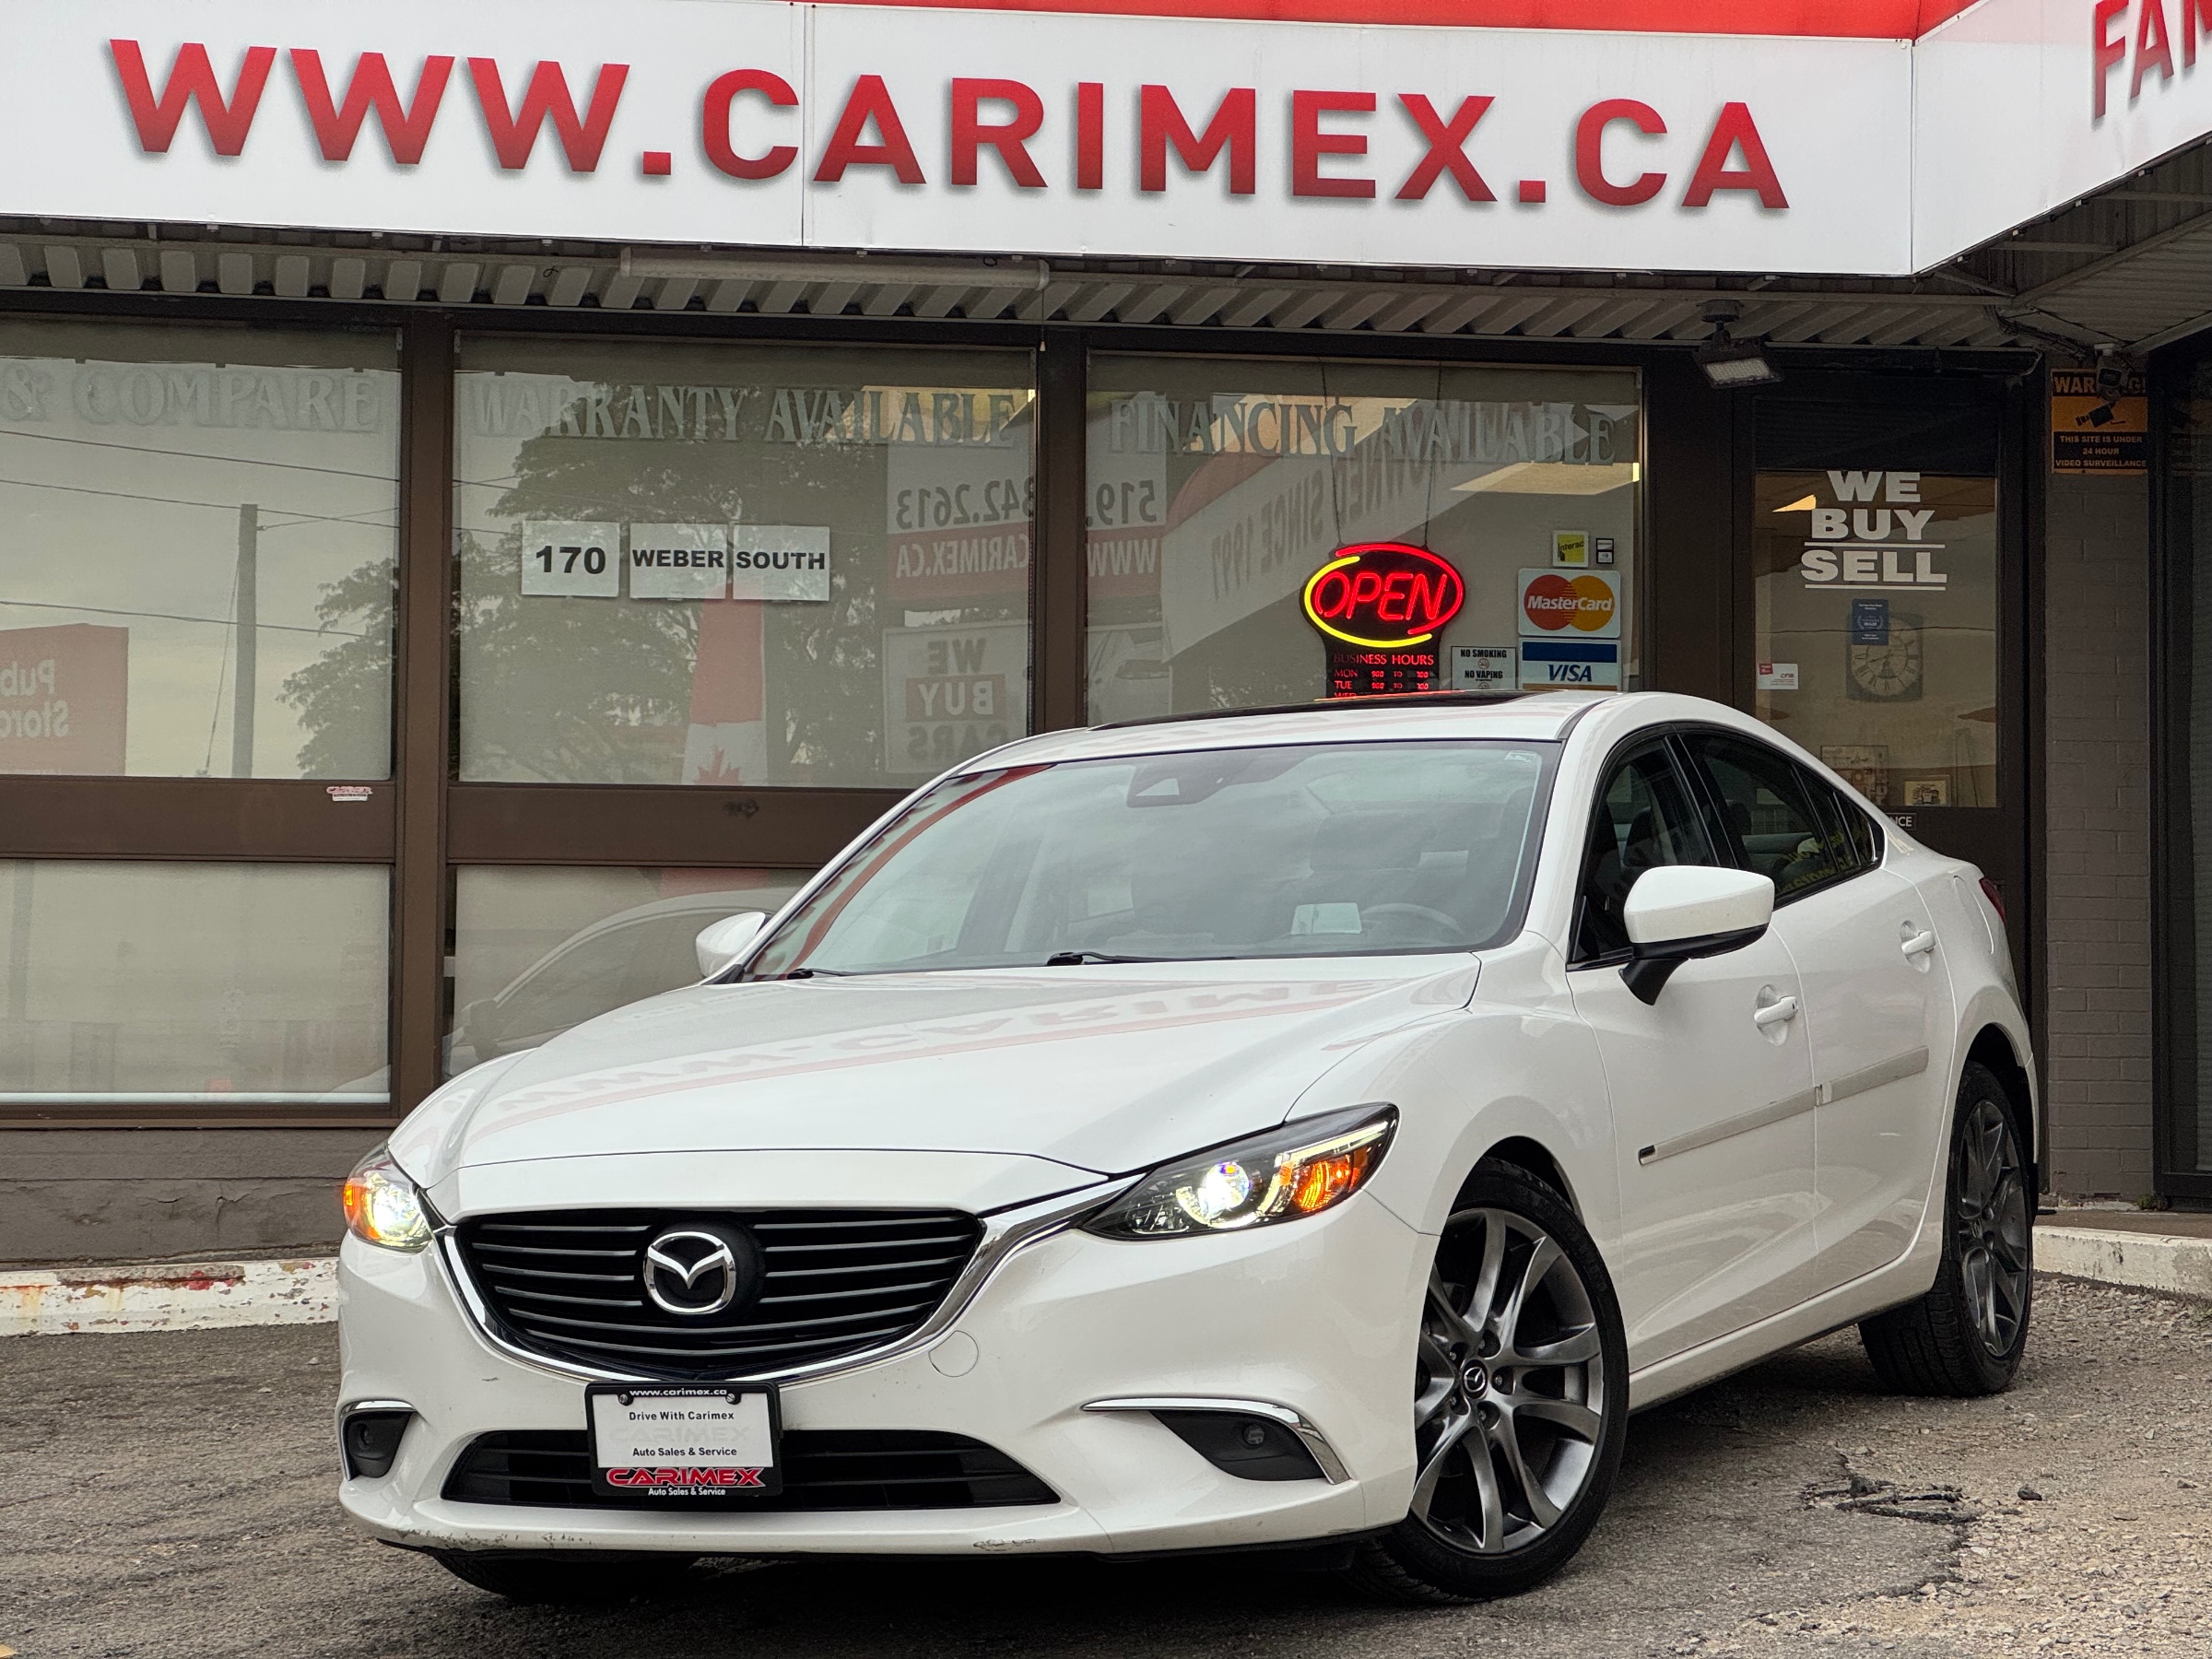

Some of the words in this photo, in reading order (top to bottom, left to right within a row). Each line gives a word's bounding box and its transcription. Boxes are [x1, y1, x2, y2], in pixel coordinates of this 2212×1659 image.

[109, 39, 1789, 209] WWW.CARIMEX.CA
[2054, 376, 2147, 394] WARG!
[74, 370, 379, 432] COMPARE
[472, 381, 746, 441] WARRANTY
[763, 387, 1015, 447] AVAILABLE
[1109, 397, 1359, 458] FINANCING
[1382, 404, 1618, 465] AVAILABLE
[2060, 435, 2079, 443] THIS
[2081, 435, 2101, 443] SITE
[2102, 435, 2112, 443] IS
[2113, 435, 2143, 443] UNDER
[2082, 447, 2093, 455] 24
[2095, 447, 2120, 455] HOUR
[2055, 459, 2081, 467] VIDEO
[2083, 459, 2147, 467] SURVEILLANCE
[1827, 470, 1921, 503] WE
[1811, 508, 1935, 541] BUY
[535, 545, 606, 575] 170
[631, 548, 724, 569] WEBER
[735, 551, 826, 571] SOUTH
[1800, 550, 1947, 583] SELL
[1314, 571, 1448, 620] OPEN
[1527, 594, 1612, 611] MasterCard
[1334, 653, 1388, 665] BUSINESS
[1391, 653, 1435, 665] HOURS
[1460, 649, 1471, 657] NO
[1472, 649, 1507, 658] SMOKING
[1334, 668, 1359, 677] MON
[1465, 670, 1475, 678] NO
[1476, 670, 1503, 679] VAPING
[1547, 664, 1593, 682] VISA
[1334, 680, 1353, 689] TUE
[629, 1388, 727, 1396] www.carimex.ca
[629, 1411, 657, 1421] Drive
[660, 1411, 685, 1420] With
[688, 1411, 735, 1420] Carimex
[632, 1447, 655, 1456] Auto
[658, 1447, 685, 1456] Sales
[688, 1447, 696, 1456] &
[699, 1446, 737, 1456] Service
[606, 1467, 766, 1488] CARIMEX
[648, 1487, 666, 1496] Auto
[668, 1487, 689, 1496] Sales
[690, 1487, 697, 1496] &
[698, 1487, 726, 1496] Service
